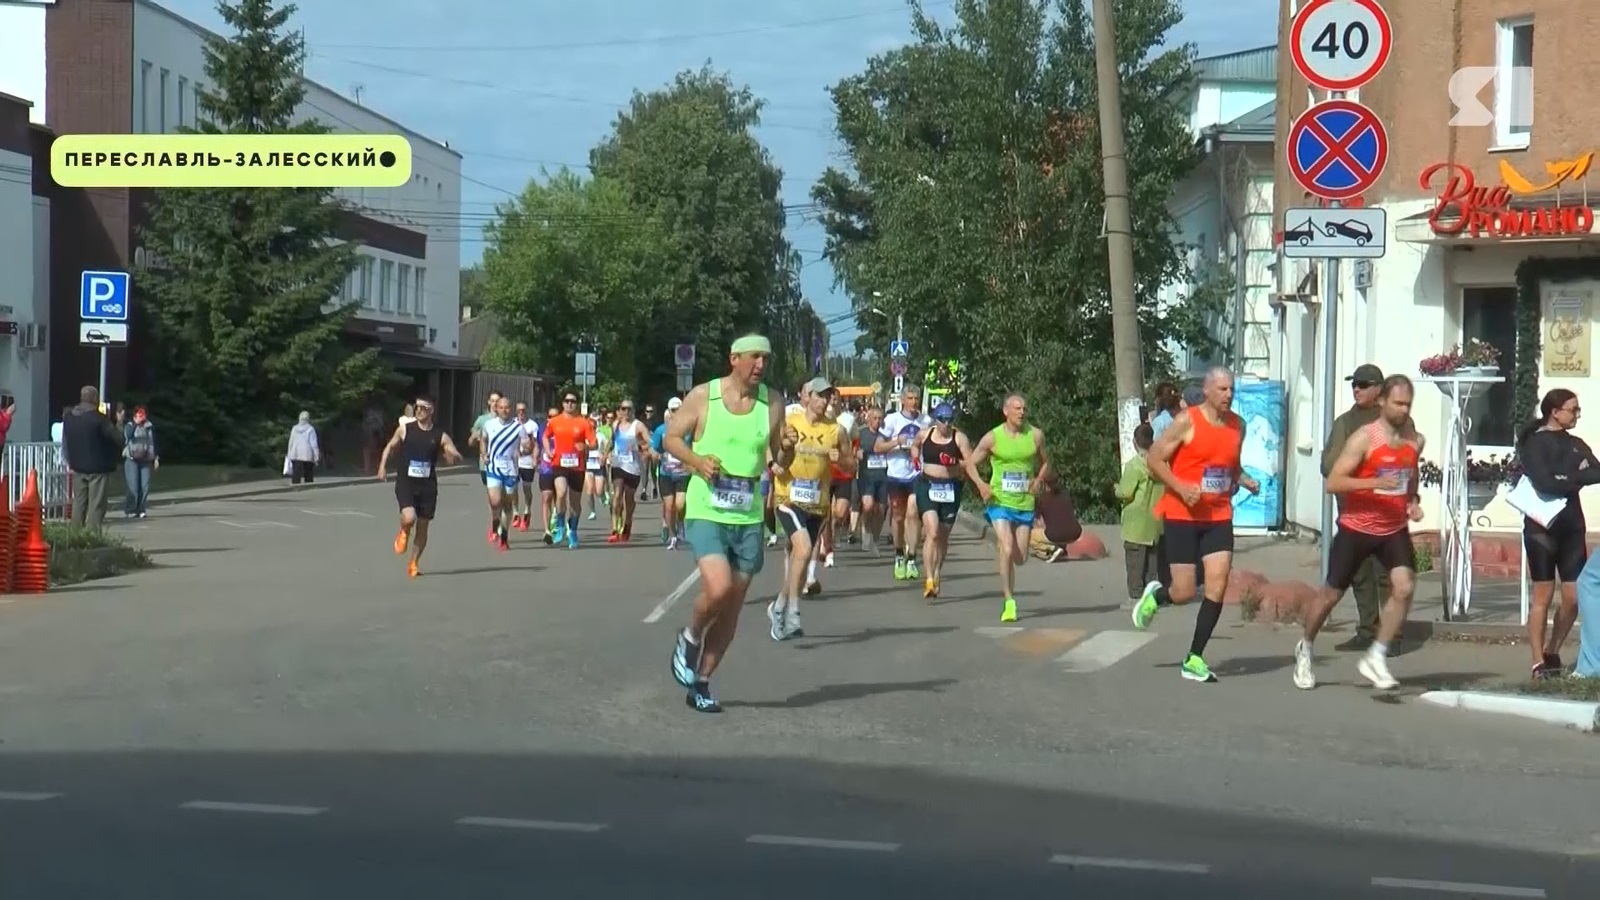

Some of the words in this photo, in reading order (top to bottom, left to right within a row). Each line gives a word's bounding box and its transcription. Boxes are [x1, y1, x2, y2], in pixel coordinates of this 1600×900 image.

[1311, 21, 1370, 60] 40
[1468, 205, 1594, 239] РОМАНО
[89, 276, 115, 313] P
[716, 491, 744, 505] 1465
